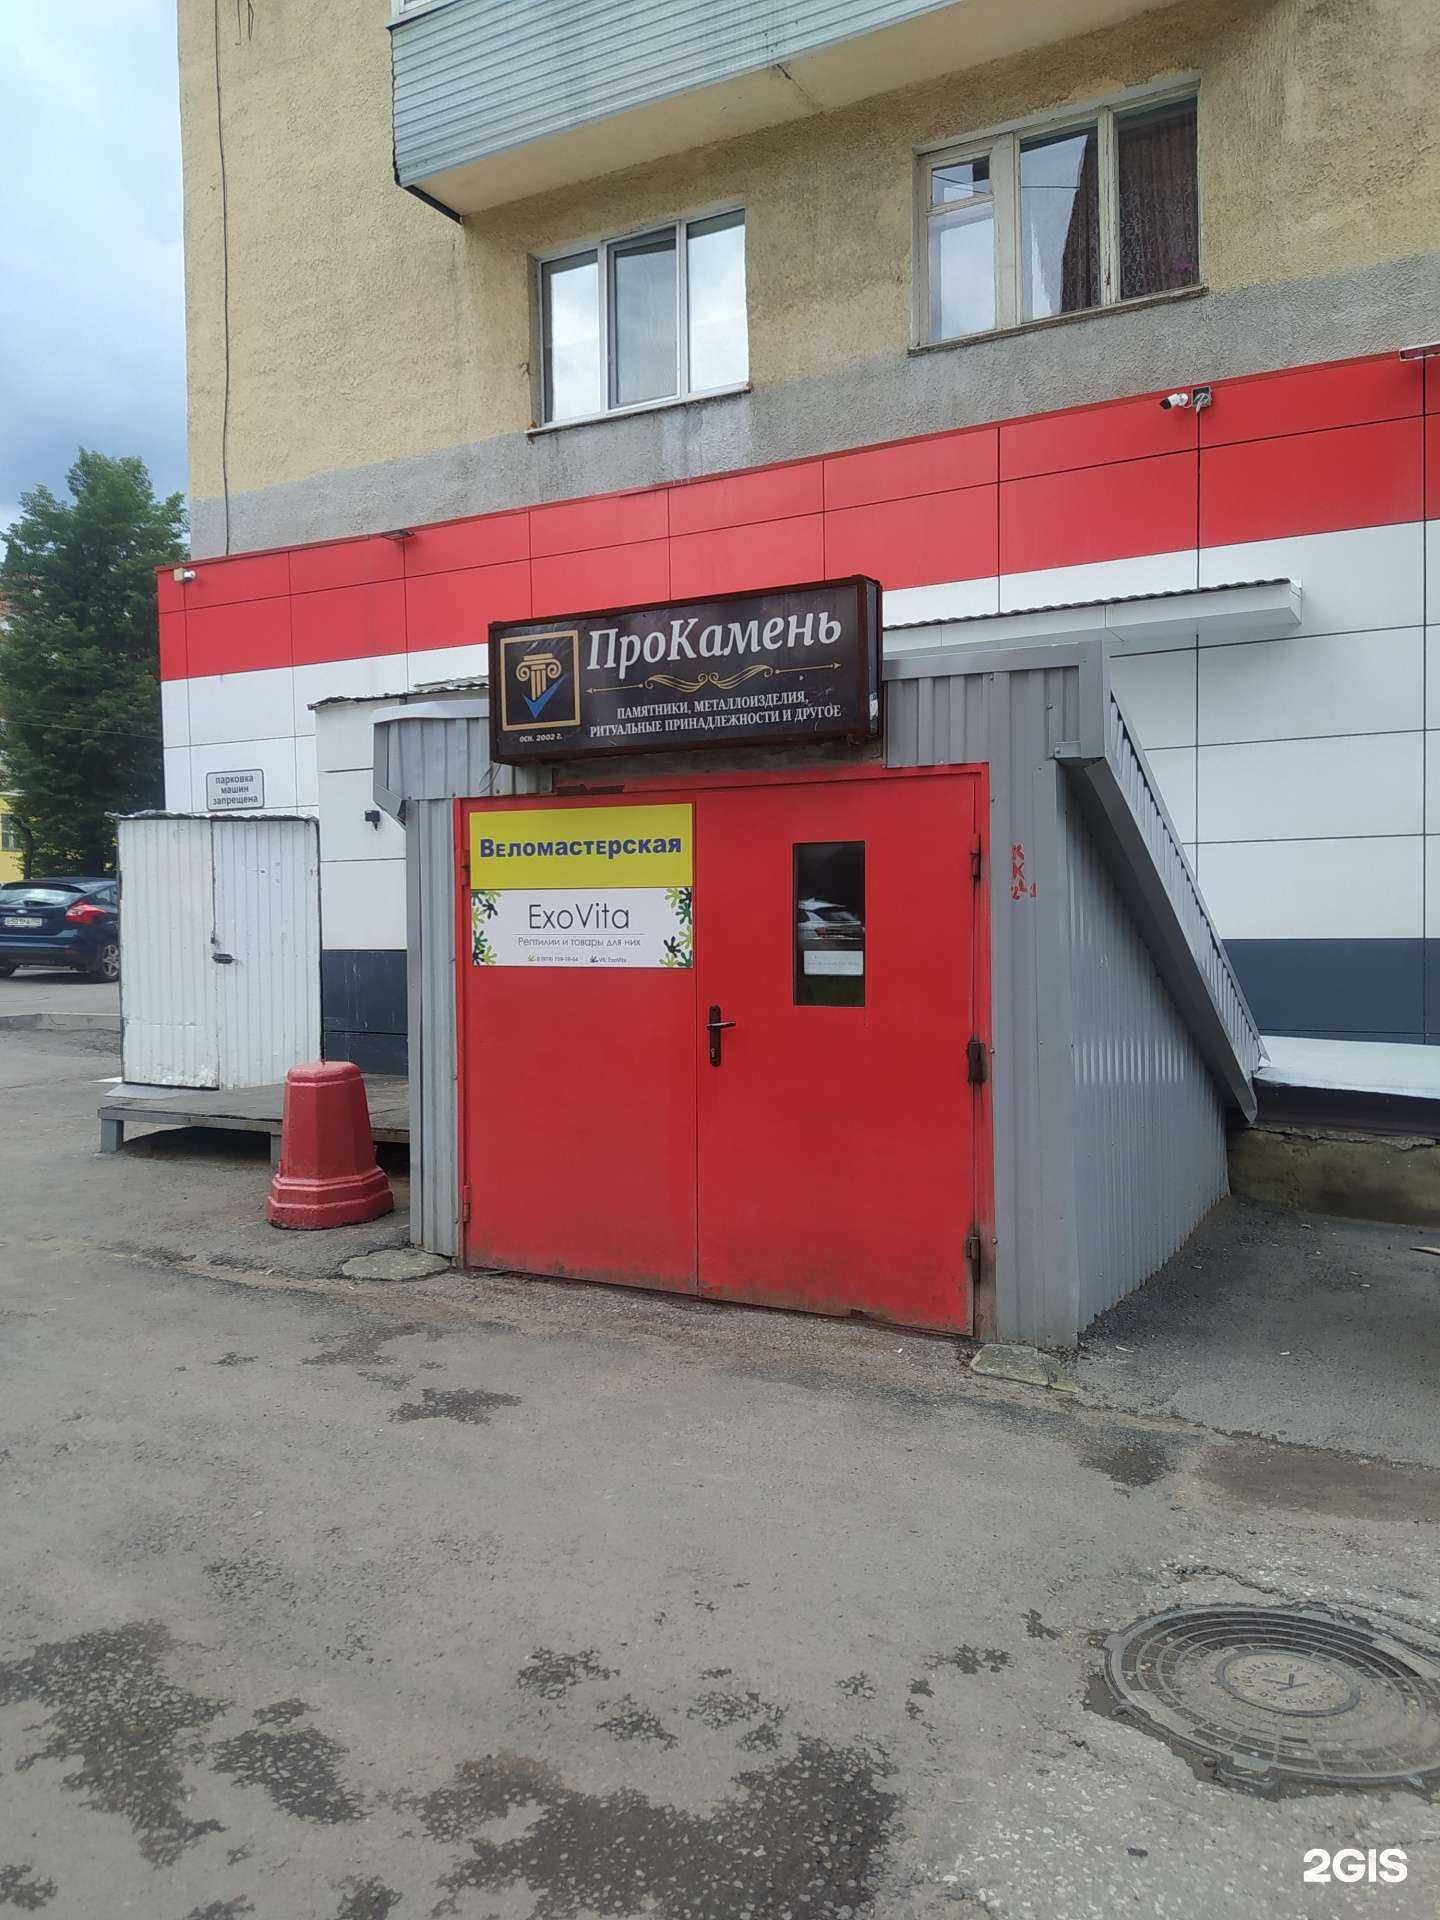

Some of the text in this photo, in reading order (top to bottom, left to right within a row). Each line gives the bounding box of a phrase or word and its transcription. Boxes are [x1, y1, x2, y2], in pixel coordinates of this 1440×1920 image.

[587, 611, 842, 679] ПроКамень
[616, 690, 809, 720] ПАМЯТНИКИ, МЕТАЛЛОИЗДЕЛИЯ,
[589, 704, 842, 738] РИТУАЛЬНЫЕ ПРИНАДЛЕЖНОСТИ И ДРУГОЕ
[535, 733, 555, 742] 2002
[215, 775, 254, 785] парковка
[213, 796, 258, 806] запрещена
[529, 902, 629, 930] ExoVita
[518, 937, 641, 949] Рептилии и товары для них
